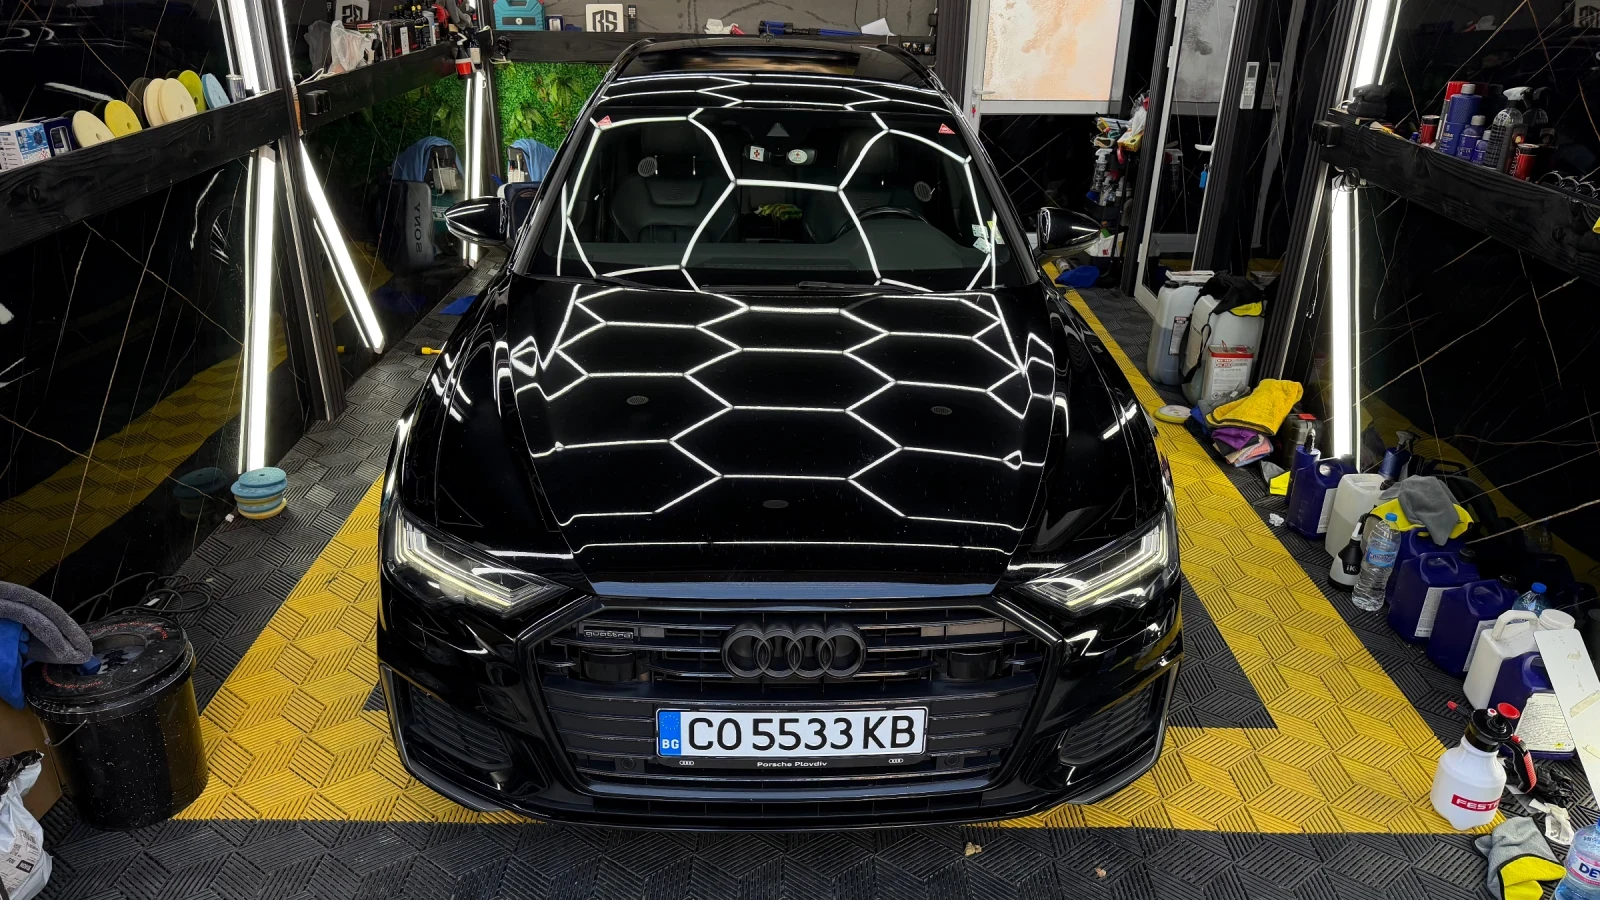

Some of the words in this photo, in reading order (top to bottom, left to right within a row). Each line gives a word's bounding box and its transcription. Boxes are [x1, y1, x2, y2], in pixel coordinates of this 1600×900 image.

[592, 9, 618, 32] RS
[585, 630, 631, 638] quattro
[688, 717, 742, 751] CO
[752, 717, 853, 751] 5533
[862, 715, 916, 749] KB
[662, 739, 679, 749] BG
[1579, 862, 1600, 879] DE
